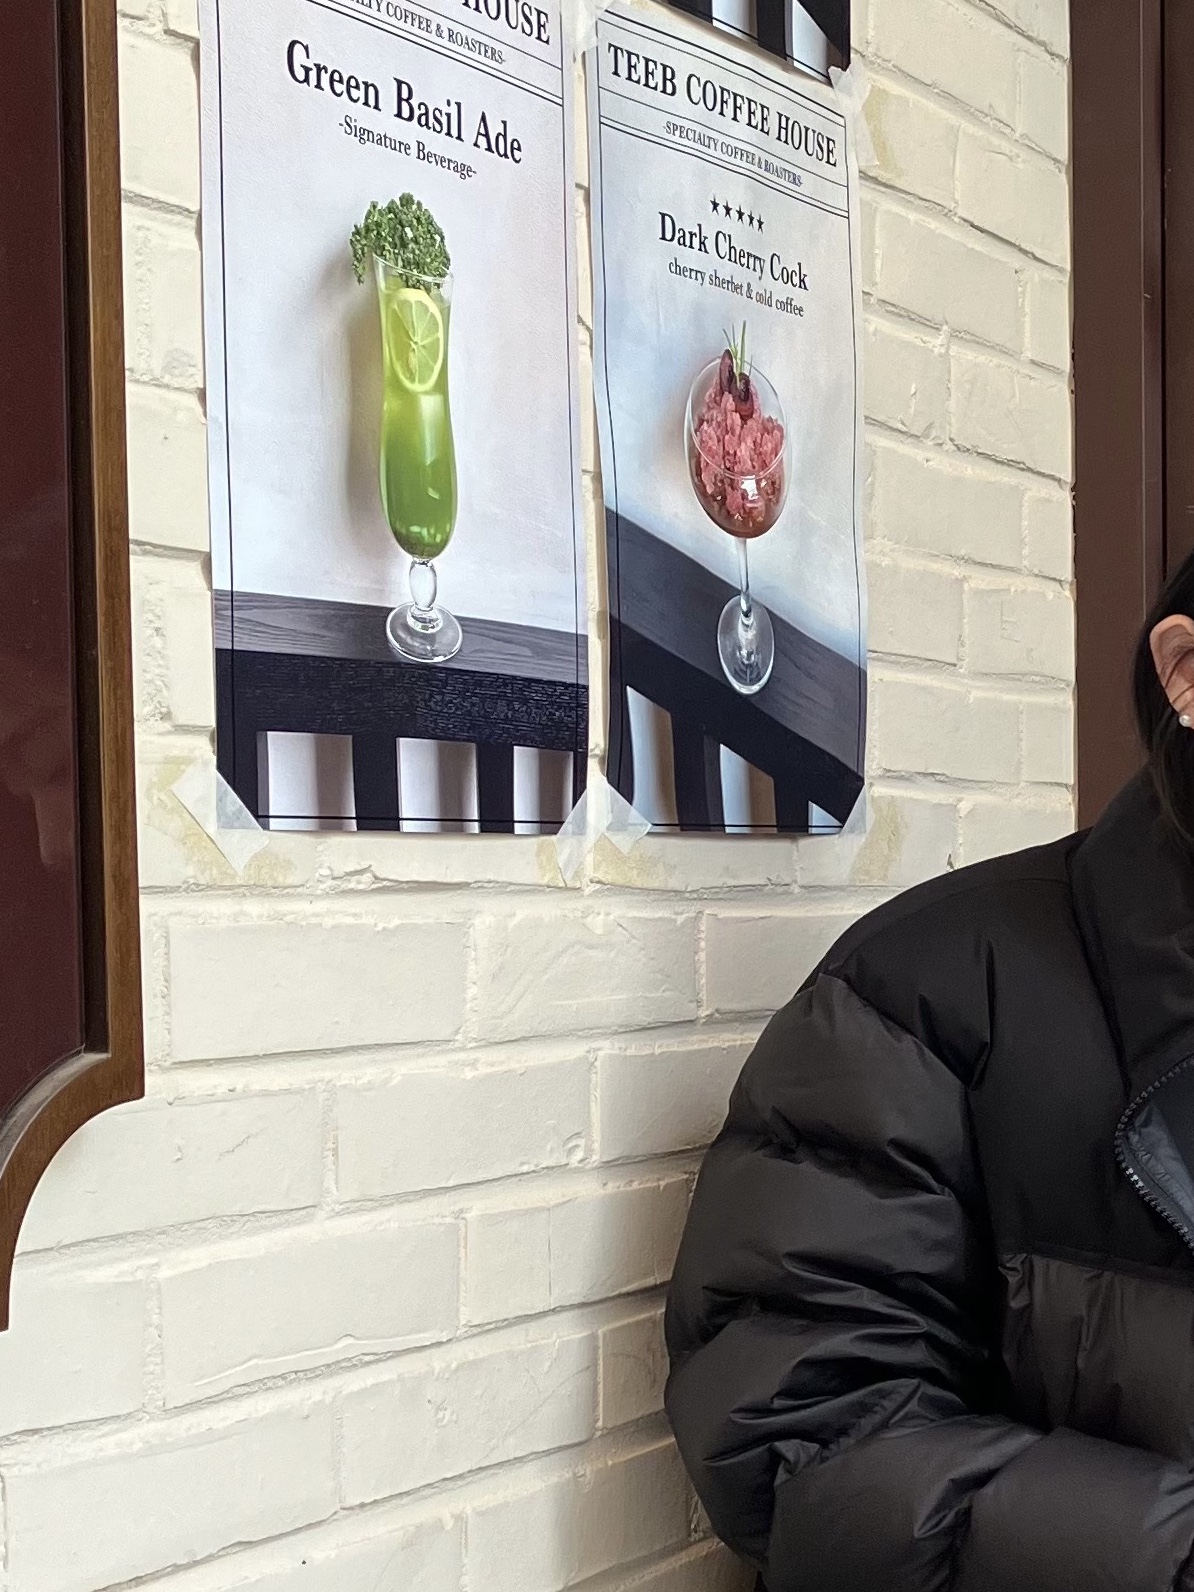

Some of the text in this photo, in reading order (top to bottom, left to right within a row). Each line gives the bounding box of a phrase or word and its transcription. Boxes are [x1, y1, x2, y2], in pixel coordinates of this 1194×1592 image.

[386, 1, 433, 34] COFFEE
[435, 22, 445, 39] &
[287, 39, 522, 164] Green Basil Ade
[607, 42, 837, 167] TEEB COFFEE HOUSE
[338, 114, 477, 180] -Signature Beverage-
[720, 141, 756, 166] COFFEE
[658, 211, 809, 291] Dark Cherry Cock
[668, 257, 804, 317] cherry sherbet & cold coffee
